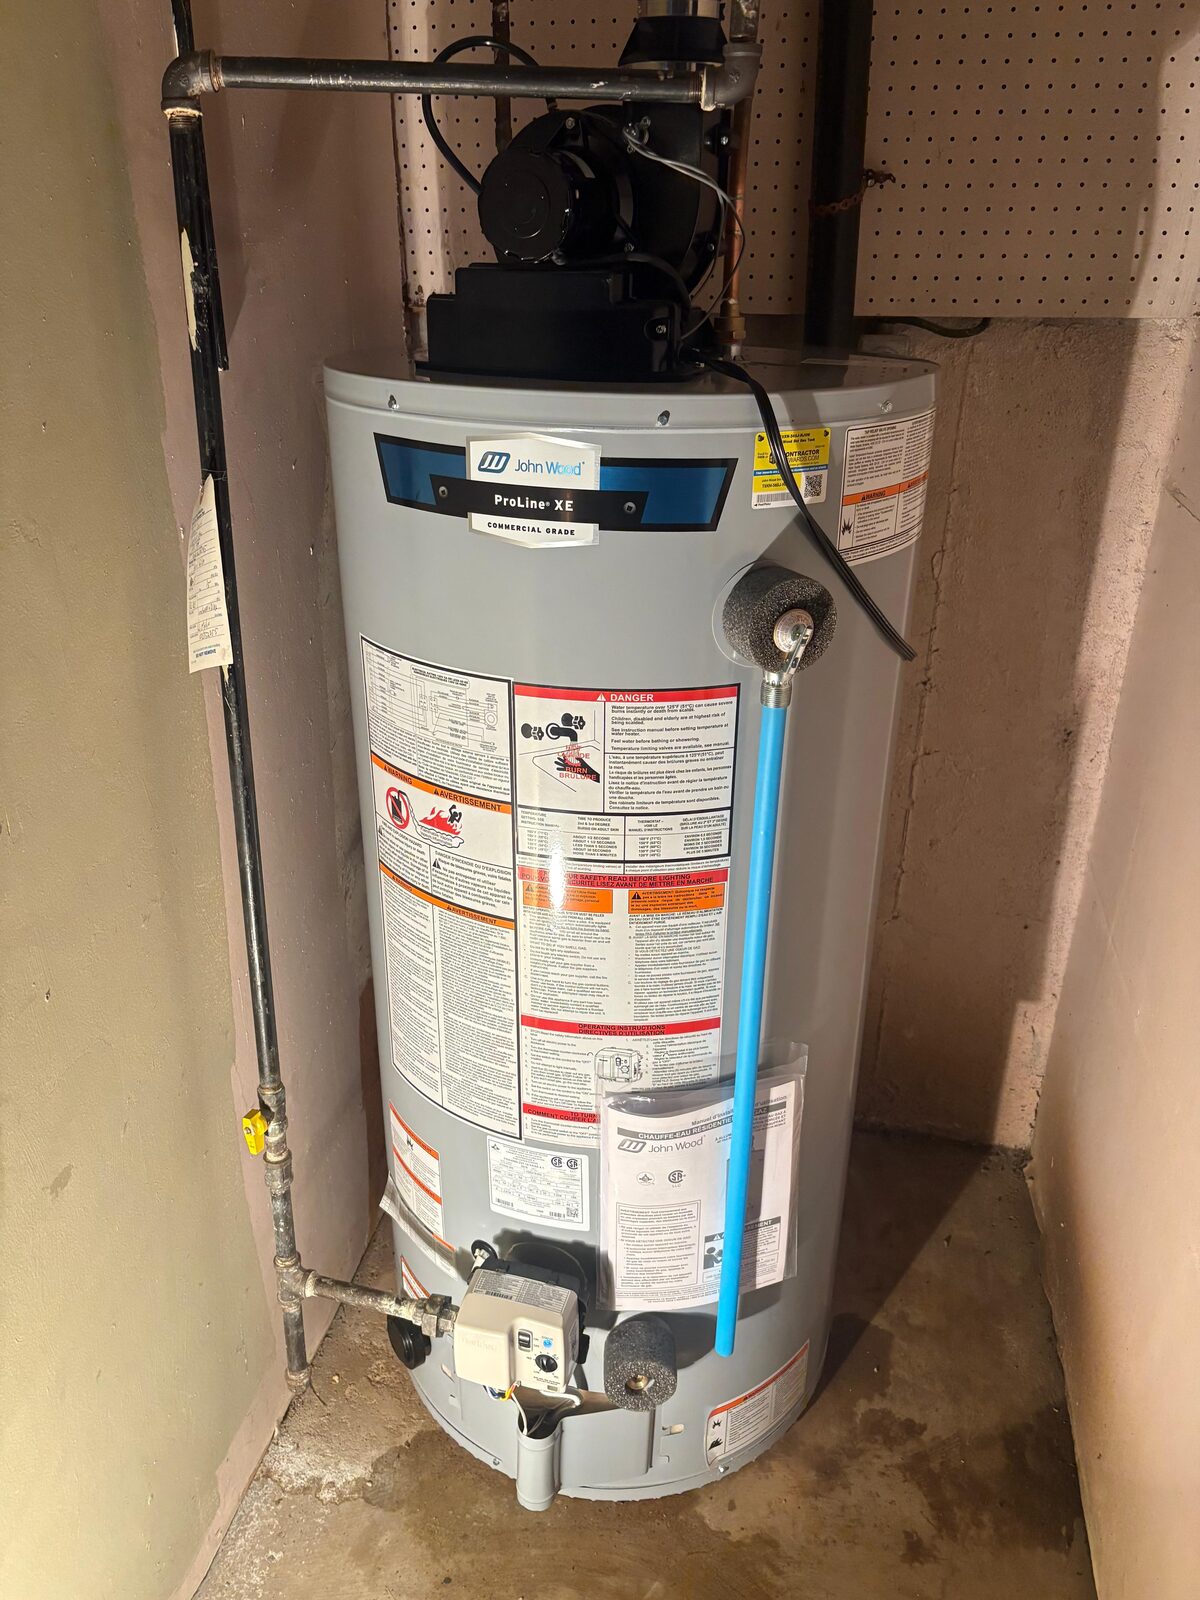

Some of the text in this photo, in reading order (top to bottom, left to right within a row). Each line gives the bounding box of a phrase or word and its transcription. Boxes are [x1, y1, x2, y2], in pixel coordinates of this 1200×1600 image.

[785, 449, 820, 457] ONTRACTOR
[515, 459, 543, 474] John
[546, 461, 582, 476] Wood
[554, 500, 574, 511] XE
[488, 522, 542, 533] COMMERCIAL
[387, 767, 412, 785] WARNING
[440, 791, 501, 811] AVERTISSEMENT
[451, 906, 496, 925] AVERTISSEMENT
[528, 1109, 559, 1119] COMMENT
[692, 1116, 712, 1126] Manuel
[638, 1130, 691, 1140] CHAUFFE-EAU
[675, 1138, 703, 1150] Wood
